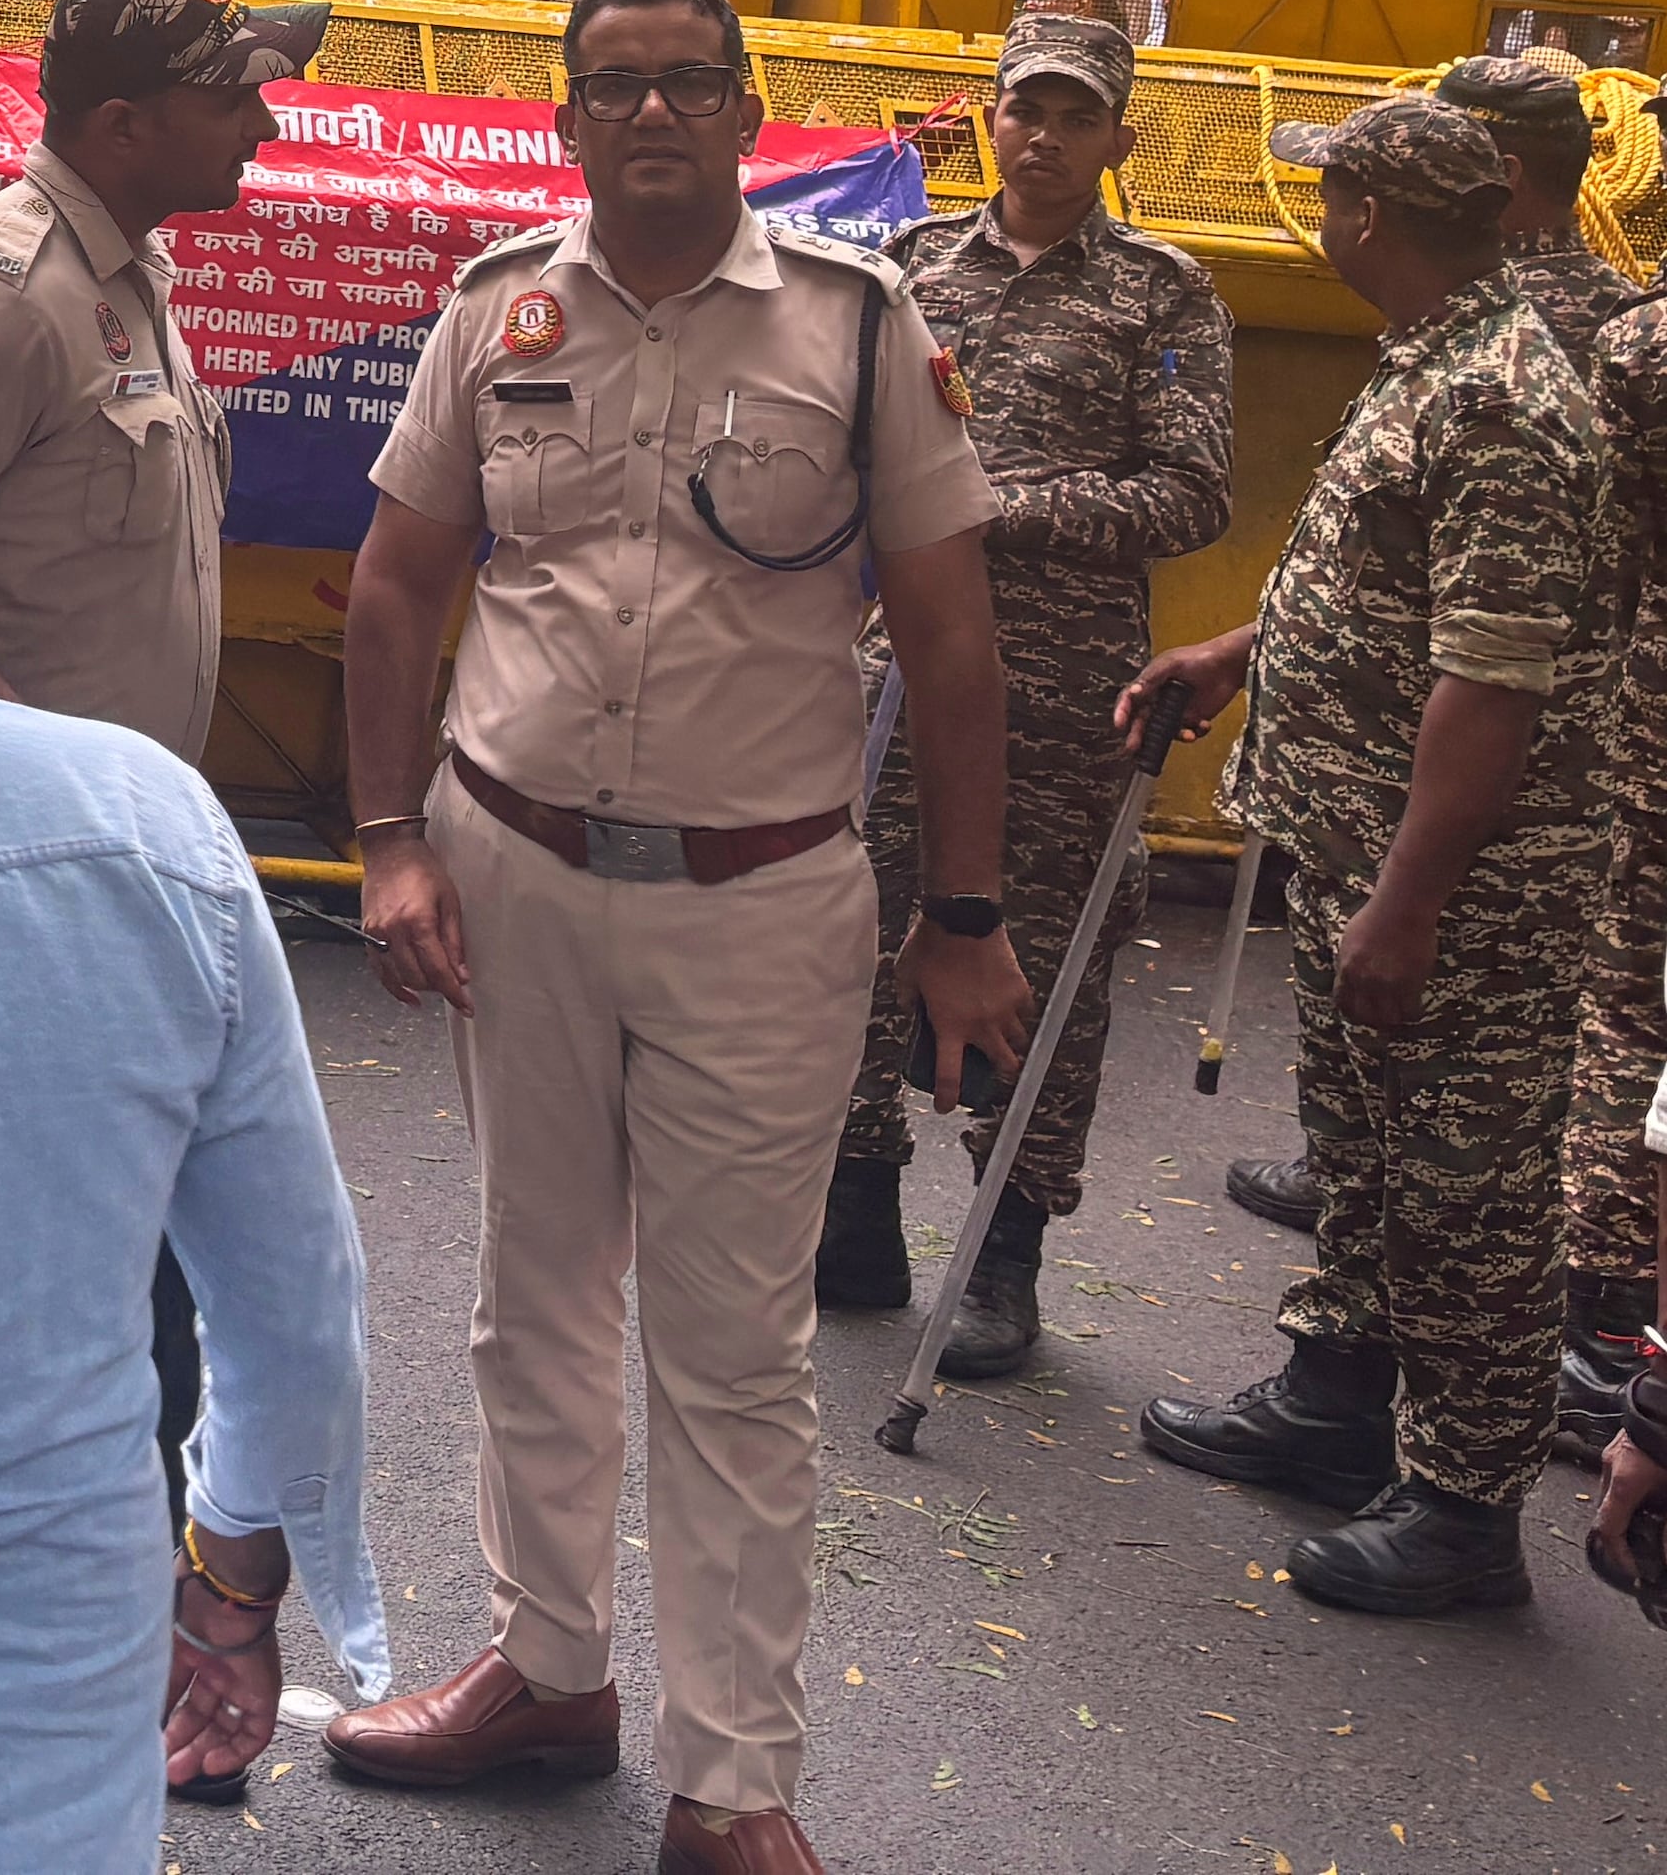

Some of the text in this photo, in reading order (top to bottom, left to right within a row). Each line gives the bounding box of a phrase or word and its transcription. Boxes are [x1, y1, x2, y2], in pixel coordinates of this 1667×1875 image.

[267, 103, 384, 151] तावनी
[418, 122, 578, 169] WARNI
[243, 163, 316, 189] किया
[324, 174, 400, 198] जाता
[407, 175, 432, 201] है
[440, 179, 482, 203] कि
[246, 196, 351, 230] अनुरोध
[366, 203, 390, 232] है
[408, 206, 450, 235] कि
[191, 228, 264, 256] करने
[277, 232, 318, 261] की
[333, 243, 439, 276] अनुमति
[234, 266, 277, 295] की
[285, 276, 327, 300] जा
[335, 279, 426, 309] सकती
[306, 316, 371, 345] THAT
[377, 324, 430, 352] PRO
[204, 344, 278, 375] HERE.
[289, 353, 343, 381] ANY
[304, 392, 332, 419] IN
